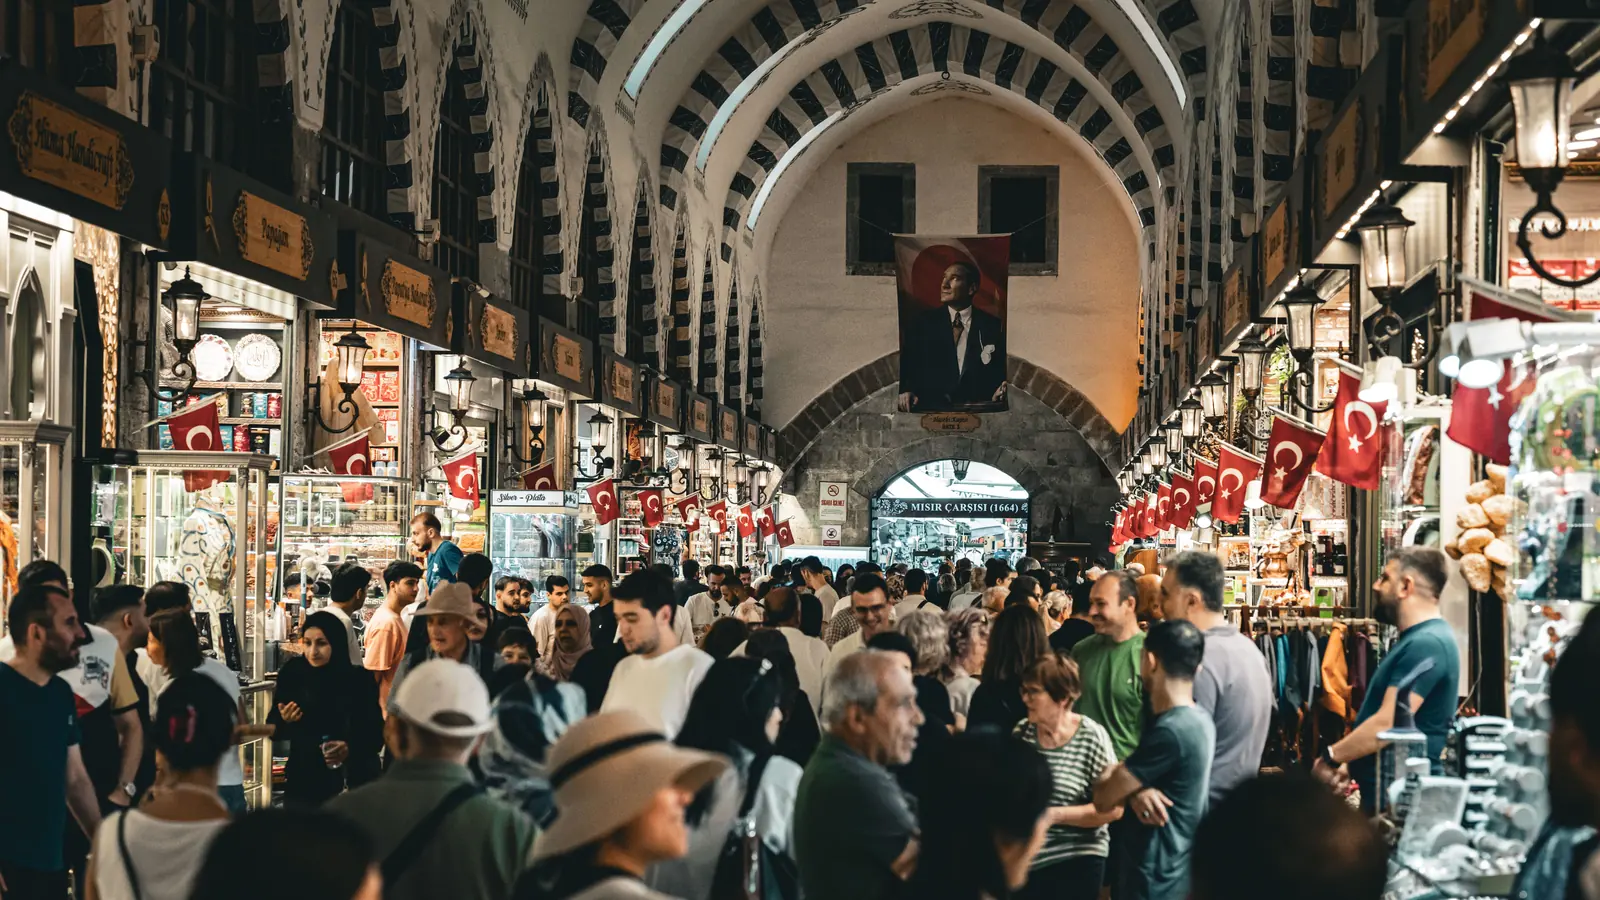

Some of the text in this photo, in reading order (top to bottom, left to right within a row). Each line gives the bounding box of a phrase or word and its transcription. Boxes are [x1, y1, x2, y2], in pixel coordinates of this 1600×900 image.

[497, 493, 518, 503] Silver
[911, 502, 1019, 514] MISIR ÇARŞISI (1664)
